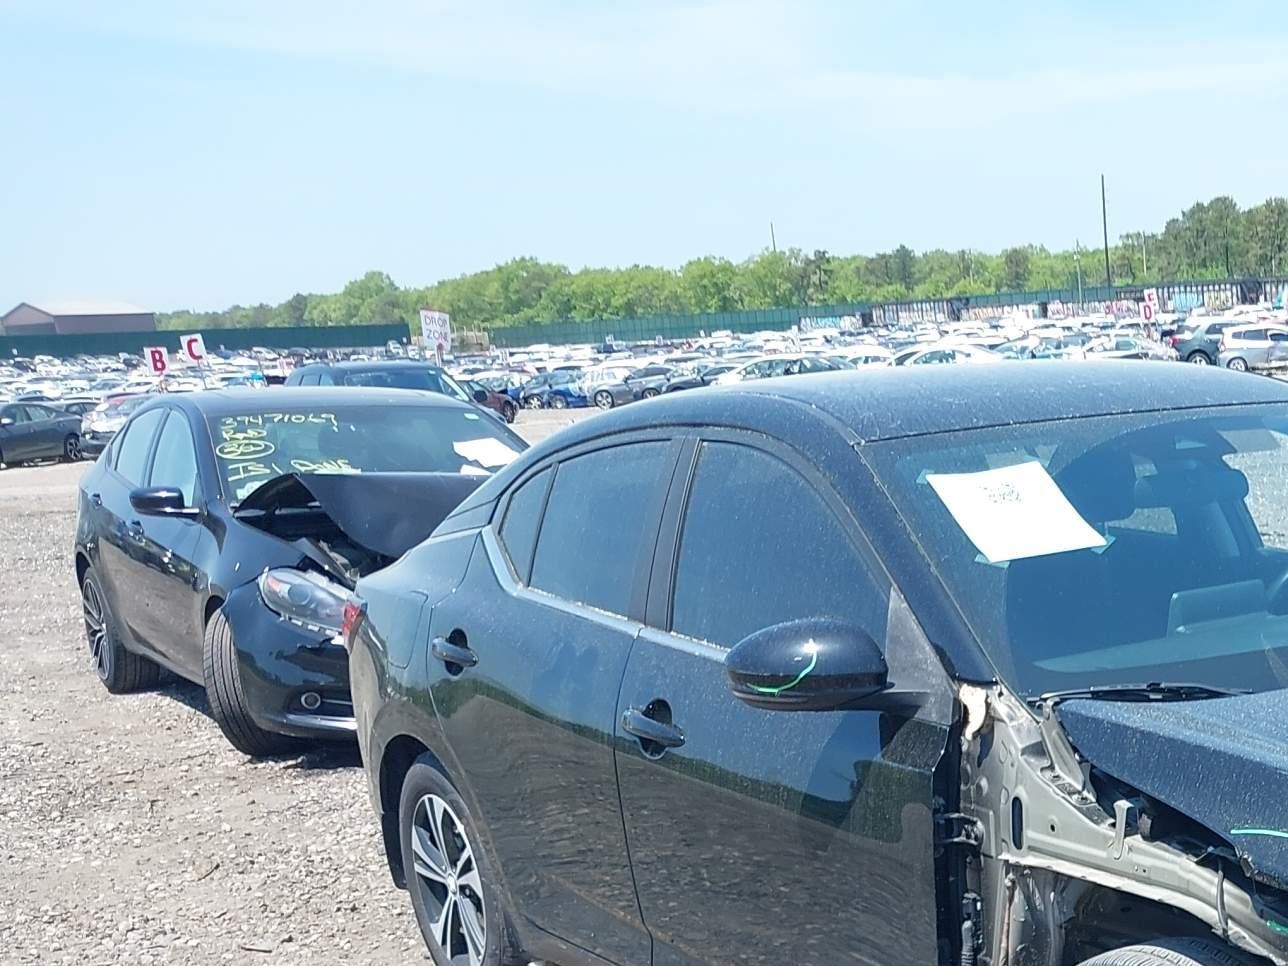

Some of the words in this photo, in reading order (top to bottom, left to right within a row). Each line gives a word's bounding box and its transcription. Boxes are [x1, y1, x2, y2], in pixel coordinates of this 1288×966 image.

[424, 314, 448, 328] DROP
[1143, 305, 1152, 320] D
[186, 338, 203, 361] C
[150, 349, 166, 372] B
